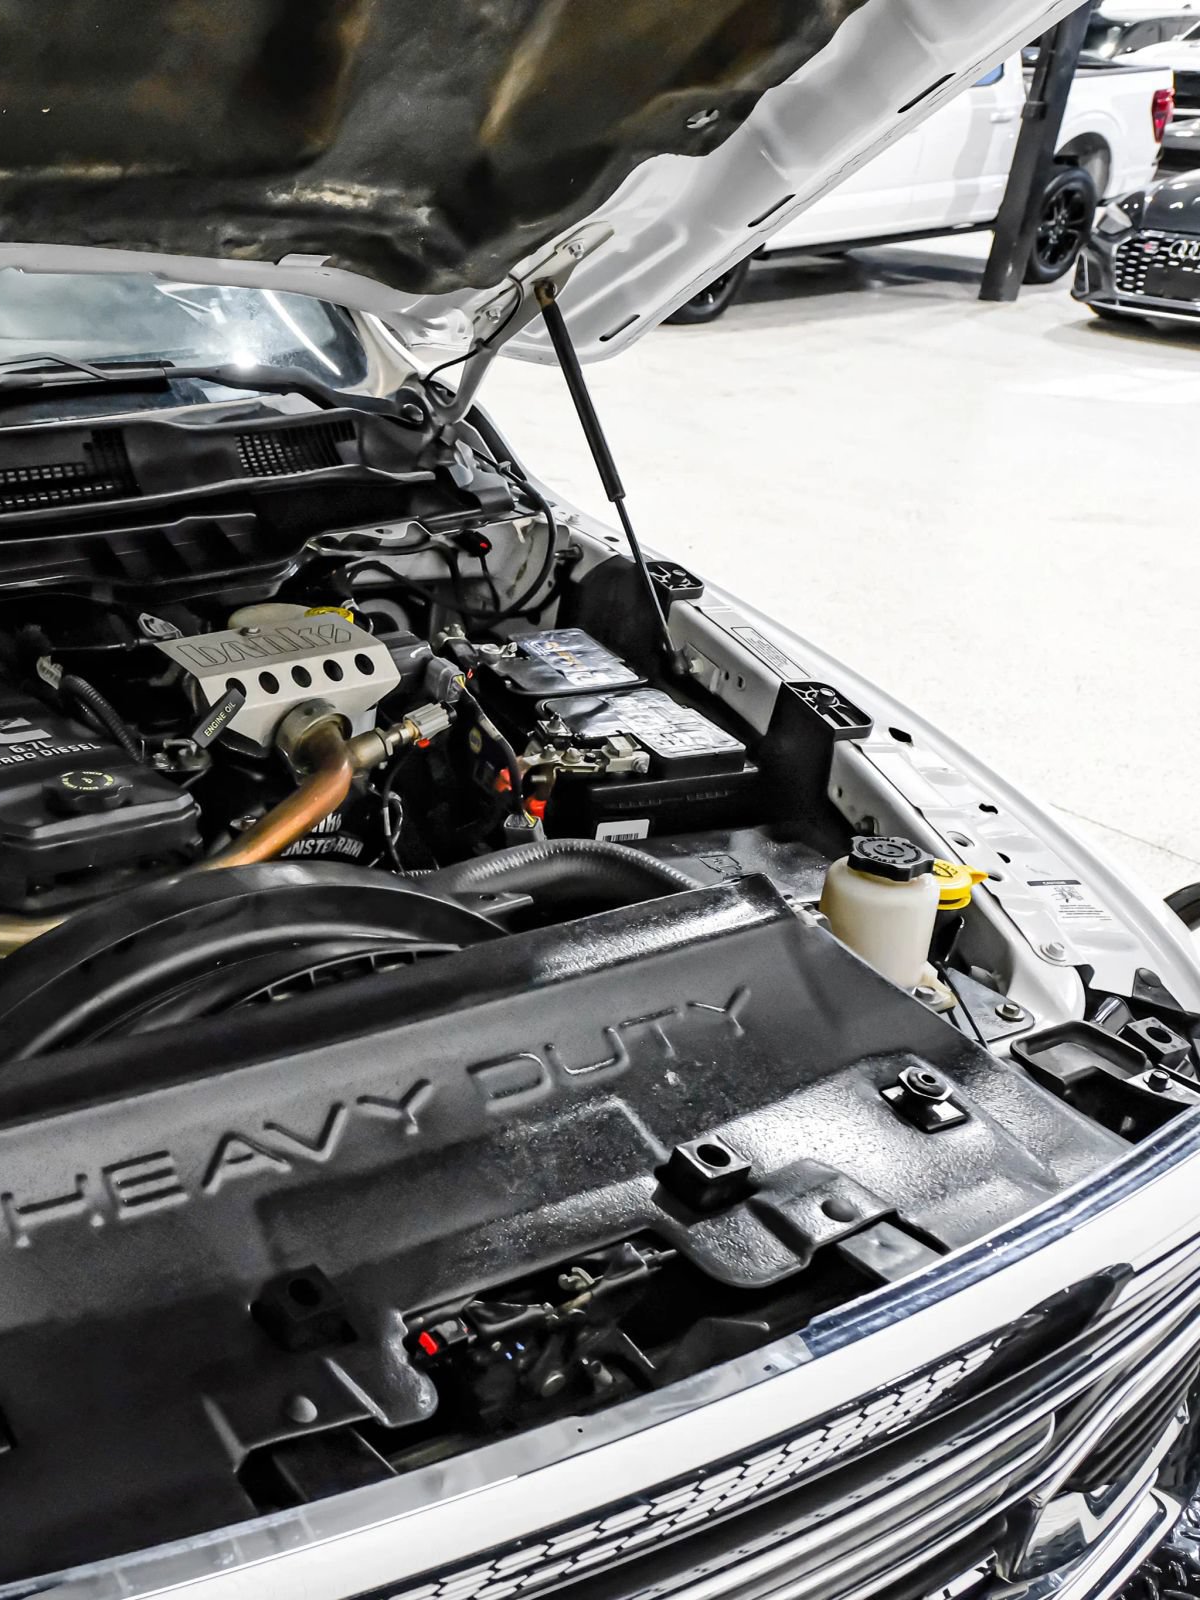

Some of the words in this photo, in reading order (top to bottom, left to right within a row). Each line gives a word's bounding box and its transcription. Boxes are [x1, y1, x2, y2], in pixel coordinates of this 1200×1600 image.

[176, 622, 352, 668] banks
[204, 711, 226, 737] ENGINE
[224, 701, 236, 713] OIL
[8, 740, 53, 753] 6.7L
[39, 742, 101, 757] DIESEL
[3, 1077, 434, 1248] HEAVY
[466, 984, 752, 1114] DUTY
